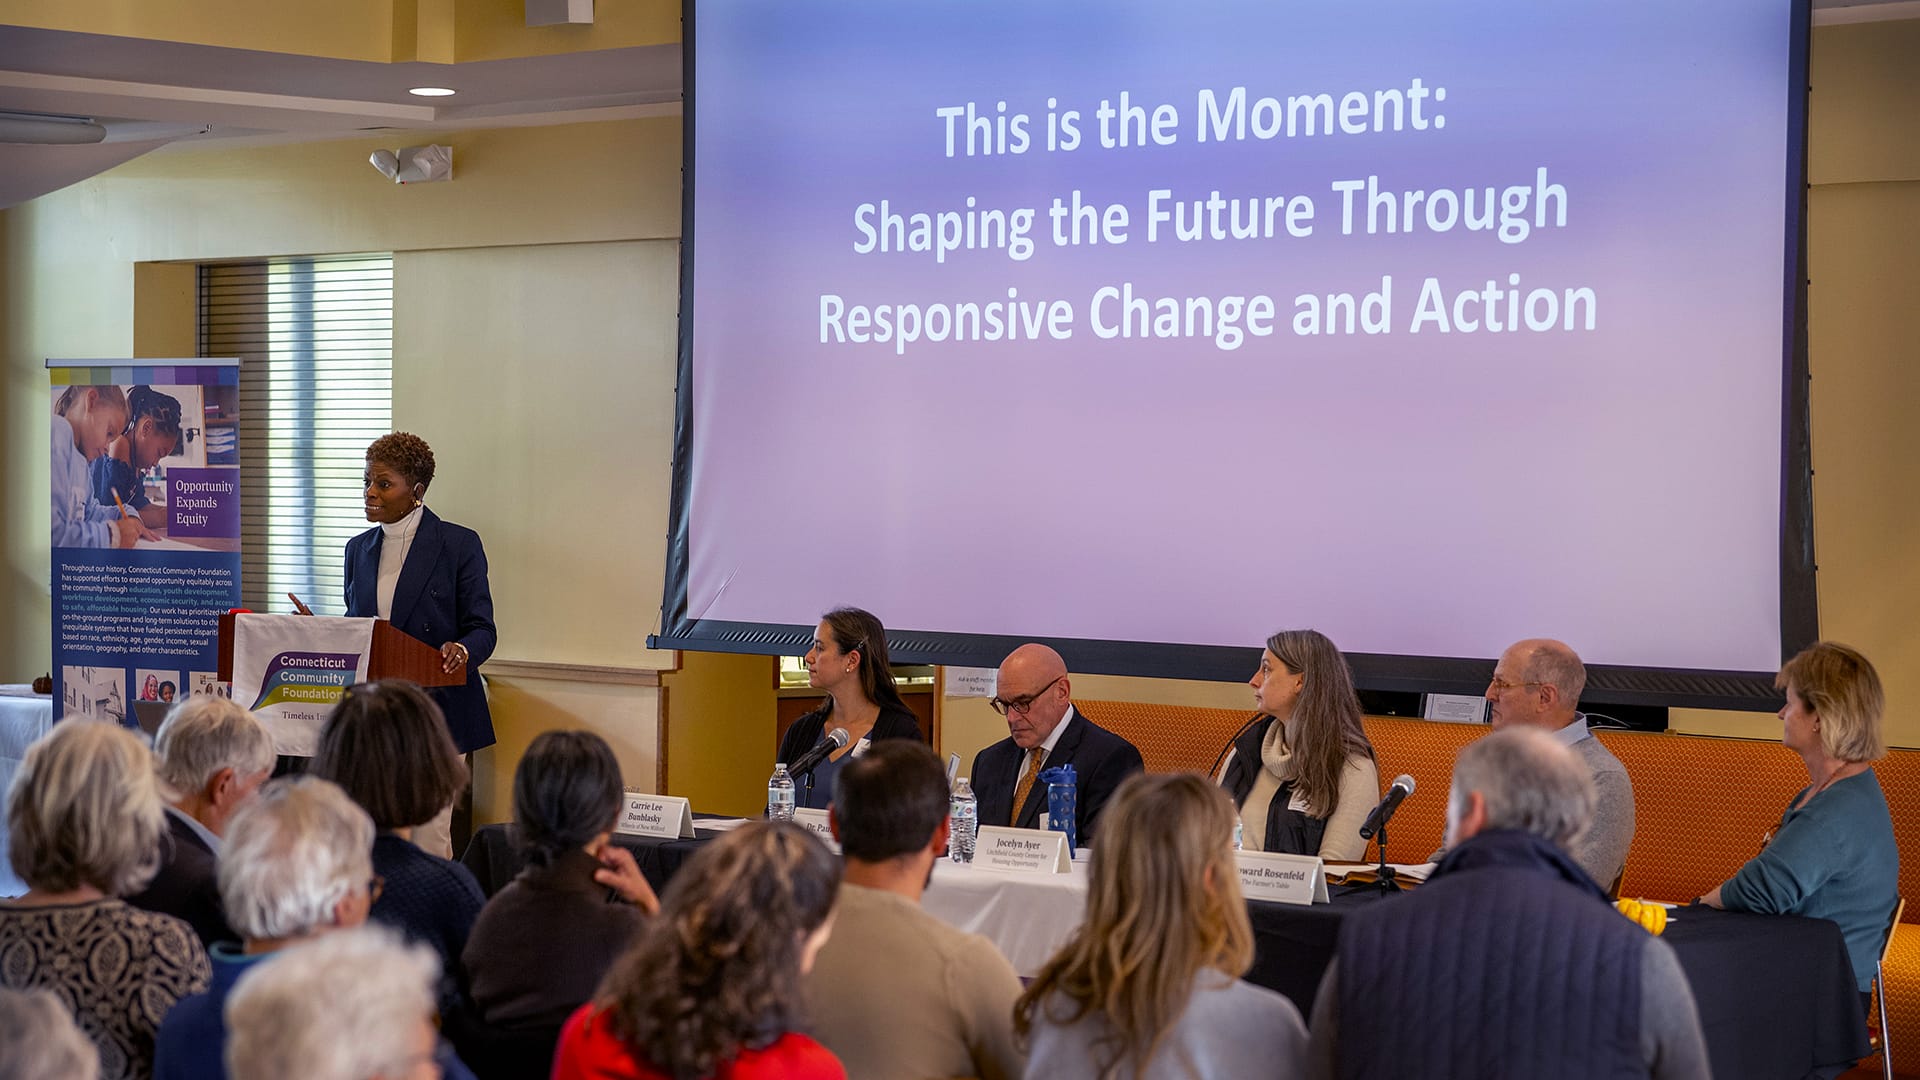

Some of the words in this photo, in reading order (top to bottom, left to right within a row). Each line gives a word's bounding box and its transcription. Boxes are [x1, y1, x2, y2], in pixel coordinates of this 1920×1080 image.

[936, 101, 1030, 157] This
[1047, 97, 1081, 151] is
[1096, 91, 1179, 148] the
[1198, 78, 1447, 142] Moment:
[853, 197, 1035, 263] Shaping
[1049, 190, 1129, 246] the
[1147, 189, 1315, 243] Future
[1332, 167, 1568, 243] Through
[819, 287, 1074, 355] Responsive
[1090, 282, 1275, 351] Change
[1292, 275, 1392, 336] and
[1409, 273, 1597, 334] Action
[176, 480, 234, 494] Opportunity
[176, 496, 218, 510] Expands
[176, 512, 208, 527] Equity
[62, 564, 95, 573] Throughout
[128, 566, 162, 574] Connecticut
[162, 567, 196, 576] Community
[198, 568, 231, 576] Foundation
[72, 574, 100, 583] supported
[151, 578, 186, 586] opportunity
[186, 578, 214, 587] equitably
[73, 585, 103, 593] community
[104, 585, 128, 594] through
[188, 608, 219, 616] prioritized
[62, 613, 102, 622] on-the-ground
[145, 616, 172, 625] long-term
[62, 622, 93, 631] inequitable
[280, 656, 346, 668] Connecticut
[280, 672, 345, 685] Community
[282, 711, 314, 720] Timeless
[631, 801, 650, 810] Carrie
[651, 802, 663, 811] Lee
[807, 822, 816, 831] Dr.
[817, 824, 832, 832] Pau
[997, 838, 1022, 850] Jocelyn
[1024, 840, 1041, 850] Ayer
[1264, 868, 1305, 880] Rosenfeld
